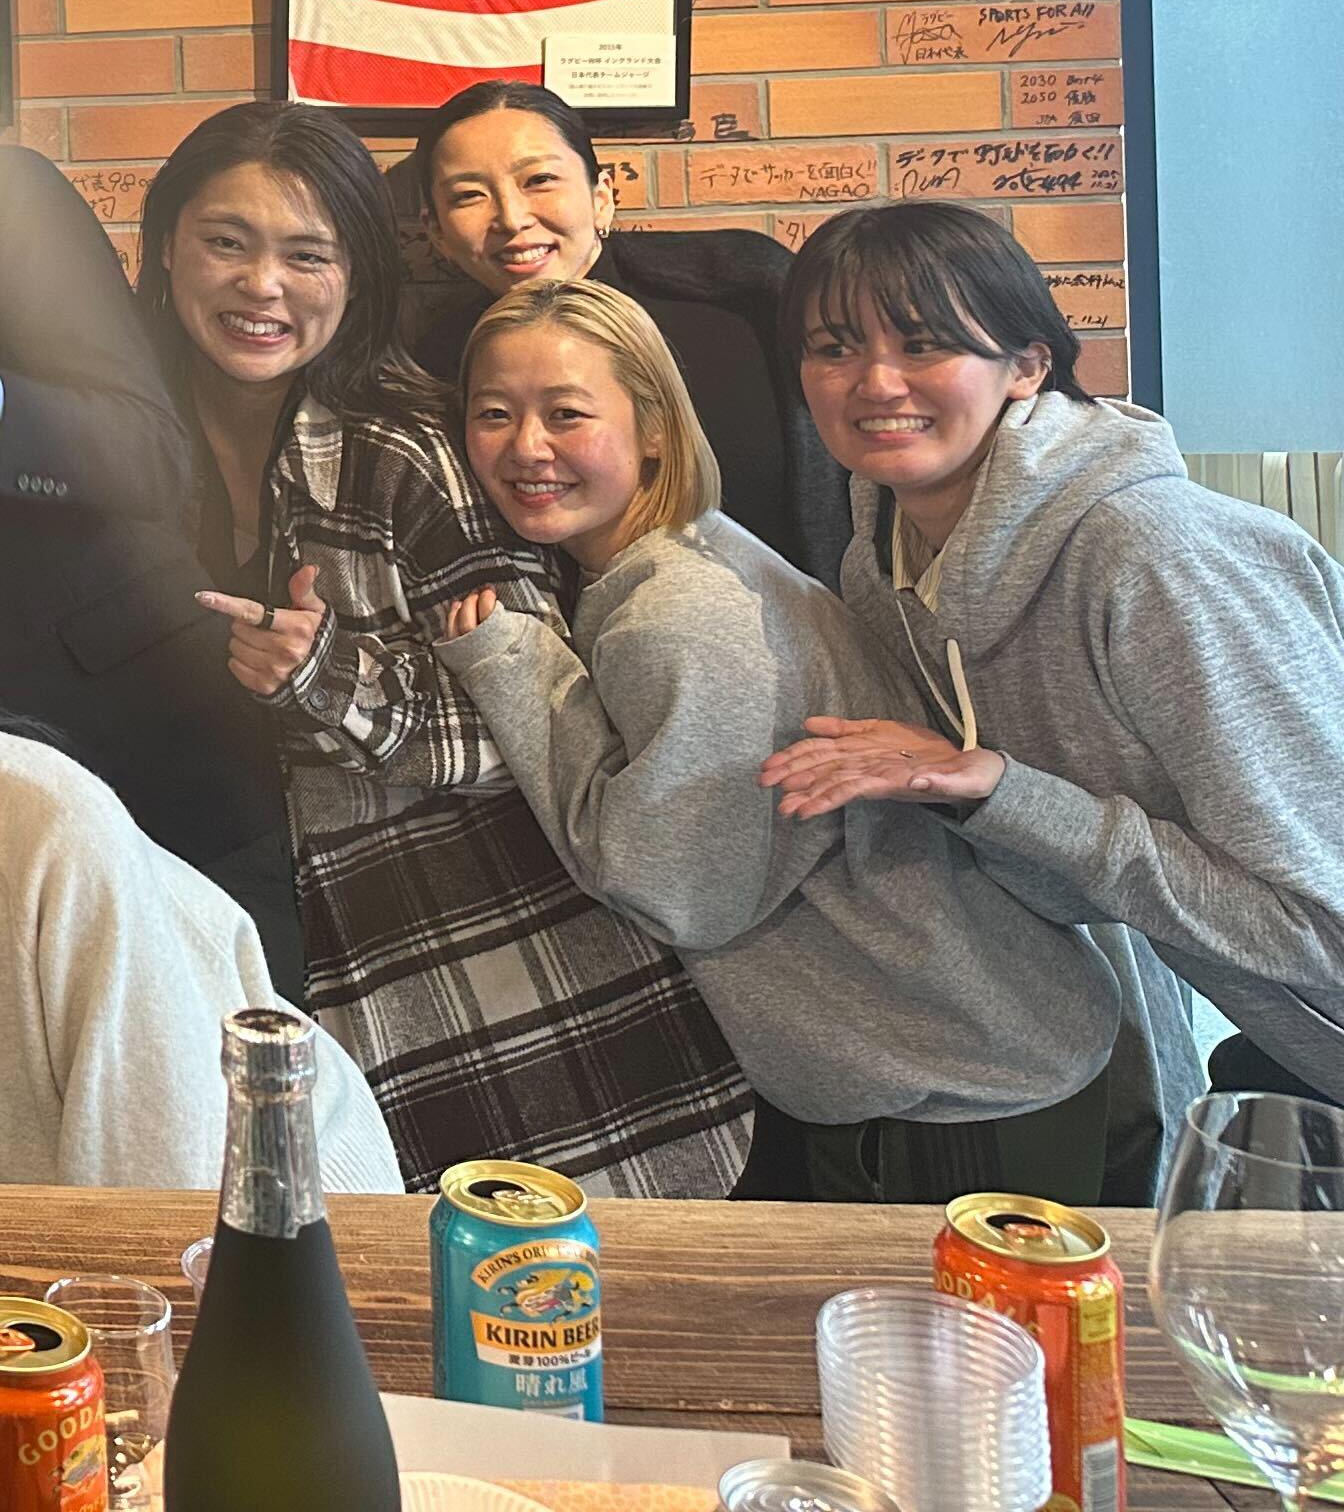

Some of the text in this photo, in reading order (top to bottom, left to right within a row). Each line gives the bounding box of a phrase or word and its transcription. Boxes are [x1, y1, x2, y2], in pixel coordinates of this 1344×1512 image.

[979, 7, 1030, 26] SPORTS
[1036, 5, 1067, 21] FOR
[1020, 73, 1057, 88] 2030
[1020, 91, 1057, 105] 2050
[799, 183, 870, 199] NAGAO
[477, 1253, 521, 1284] KIRIN'S
[485, 1316, 599, 1349] KIRIN BEER
[17, 1405, 92, 1465] GOOD
